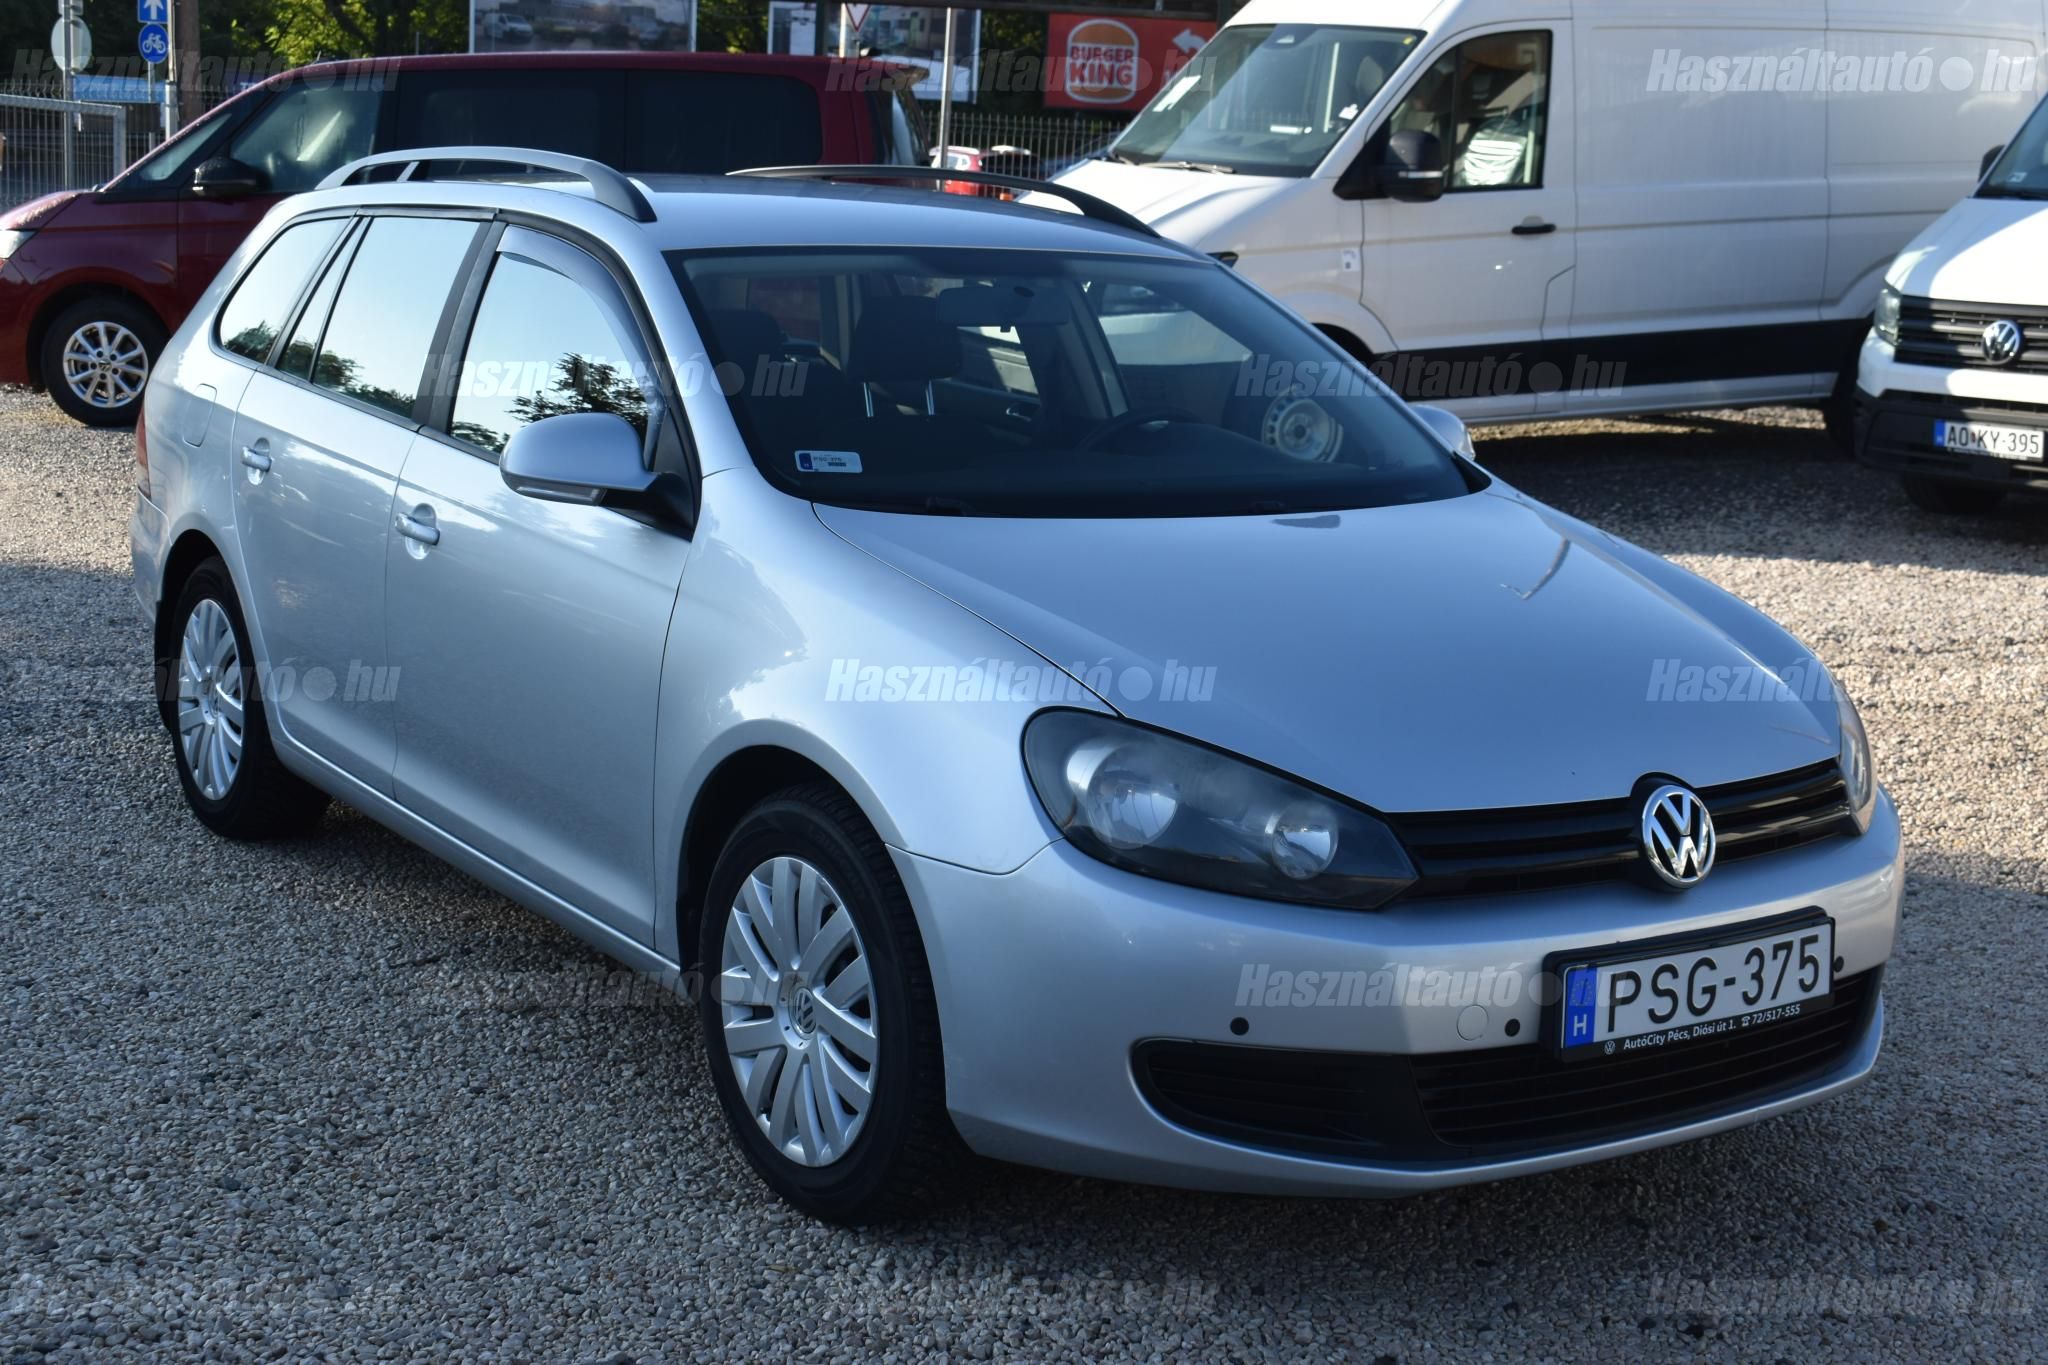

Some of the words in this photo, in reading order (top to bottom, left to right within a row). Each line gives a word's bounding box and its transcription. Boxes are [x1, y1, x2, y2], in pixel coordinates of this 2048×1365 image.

[1071, 45, 1133, 63] BURGER
[1069, 61, 1133, 86] KING
[1606, 934, 1820, 1033] PSG-375
[1573, 1014, 1588, 1037] H
[1623, 1033, 1666, 1050] AutóCity
[1693, 1023, 1716, 1037] Diósi
[1717, 1020, 1727, 1033] út
[1728, 1019, 1736, 1031] 1.
[1751, 1004, 1801, 1025] 72/517-555
